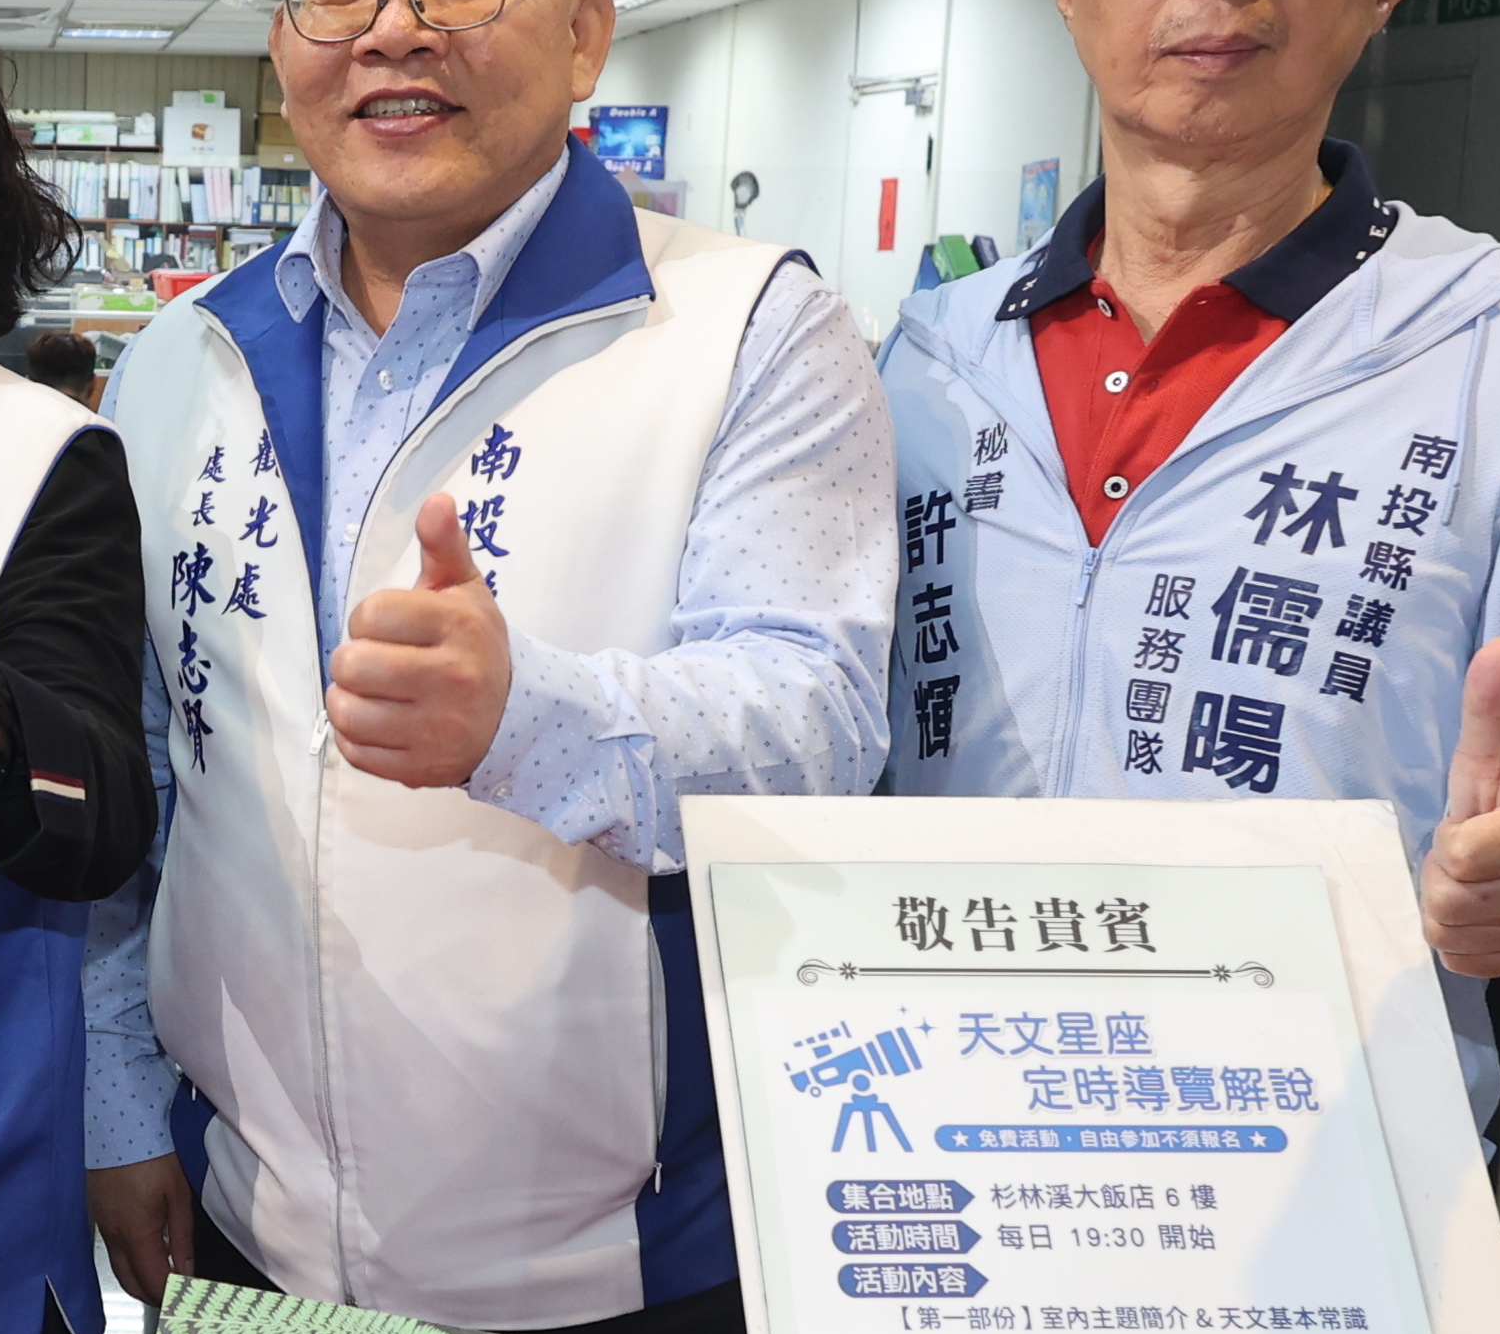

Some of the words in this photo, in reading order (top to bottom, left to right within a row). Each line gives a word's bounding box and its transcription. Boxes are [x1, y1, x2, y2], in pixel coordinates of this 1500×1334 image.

[1317, 432, 1460, 706] 南投縣議員
[1123, 573, 1197, 776] 服務團隊
[891, 895, 1158, 954] 敬告貴賓
[957, 1010, 1154, 1057] 天文星座
[1022, 1063, 1323, 1115] 定時導覽解說
[978, 1127, 1243, 1151] 免費活動，自由參加不須報名
[841, 1184, 955, 1212] 集合地點
[990, 1183, 1156, 1212] 杉林溪大飯店
[1165, 1188, 1180, 1208] 6
[1190, 1183, 1219, 1212] 樓
[846, 1223, 961, 1253] 活動時間
[997, 1224, 1055, 1251] 每日
[1071, 1227, 1147, 1250] 19:30
[1159, 1223, 1218, 1253] 開始
[852, 1265, 968, 1296] 活動內容
[1196, 1309, 1213, 1330] &
[1218, 1306, 1369, 1333] 天文基本常識
